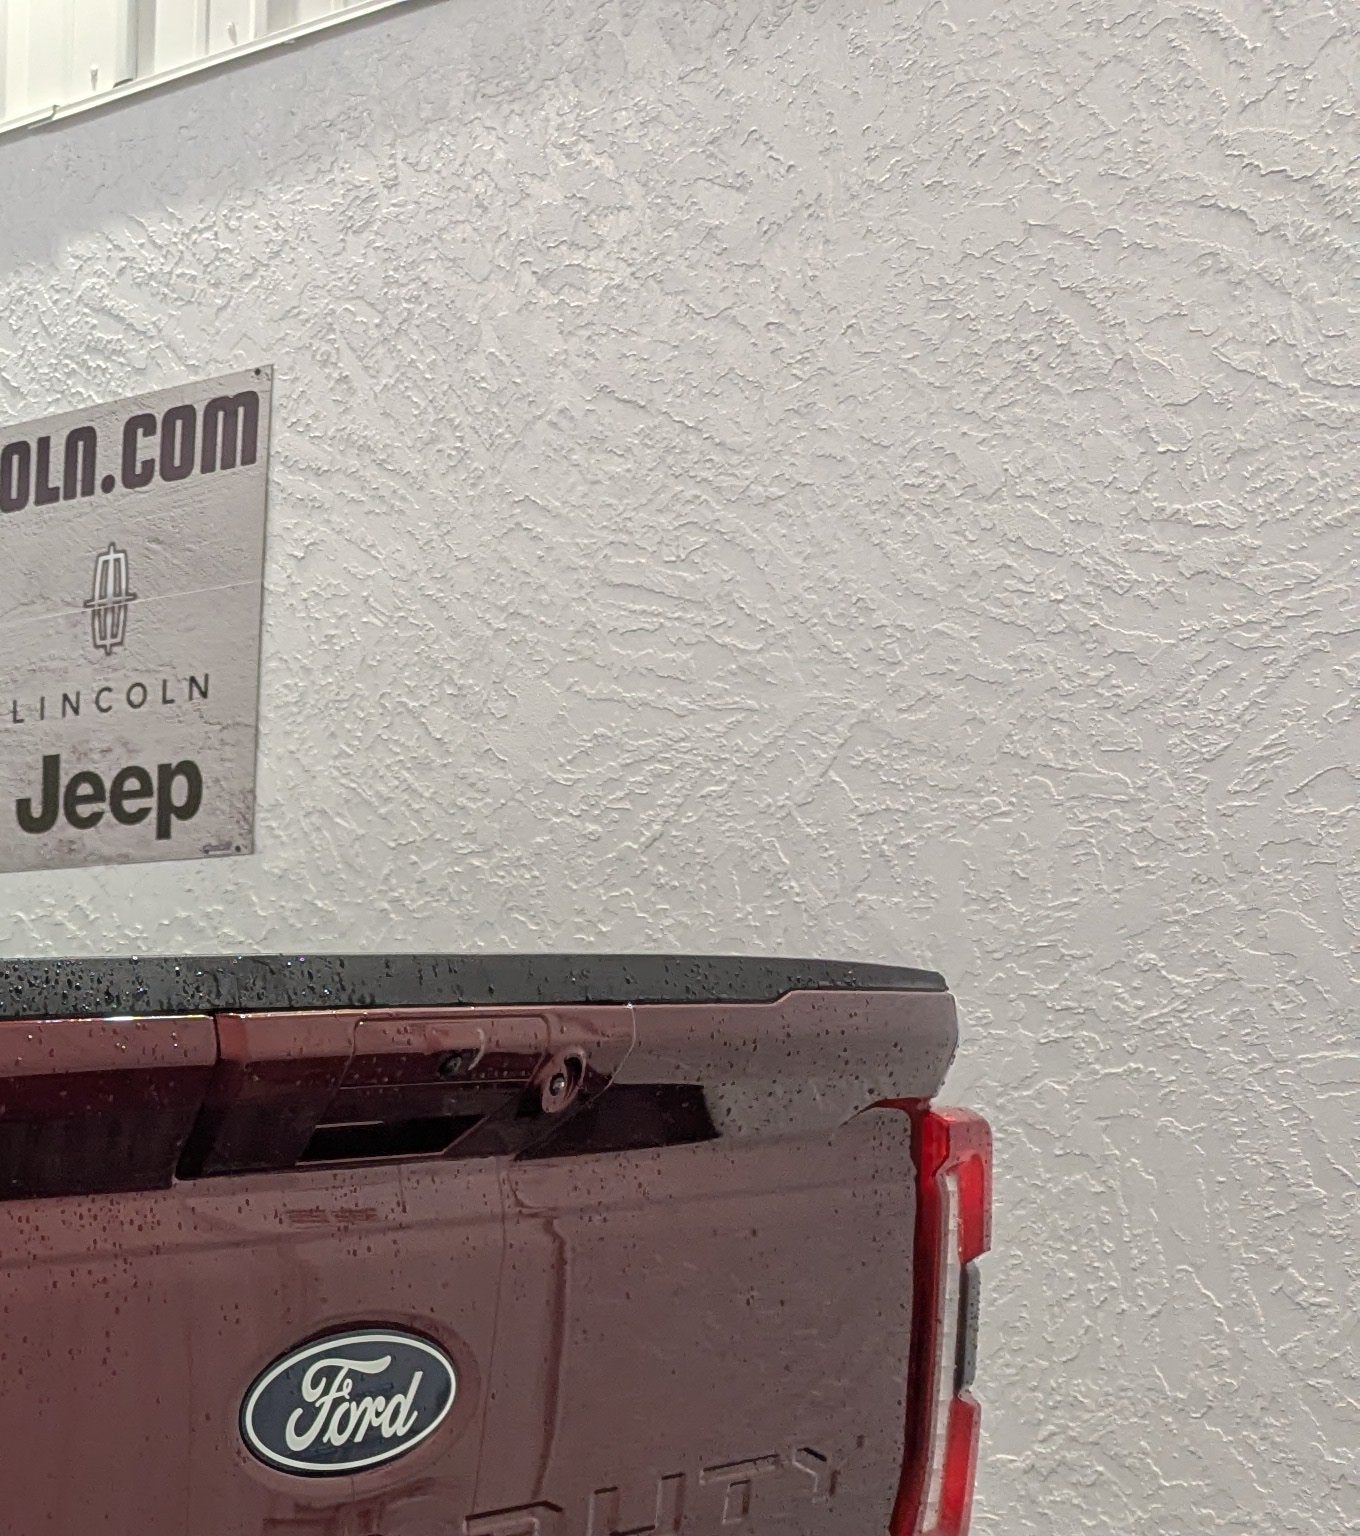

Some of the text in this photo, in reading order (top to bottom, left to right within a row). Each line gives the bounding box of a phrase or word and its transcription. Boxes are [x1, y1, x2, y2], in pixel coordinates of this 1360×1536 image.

[12, 673, 209, 724] LINCOLN
[15, 753, 203, 840] Jeep
[285, 1354, 424, 1453] Ford
